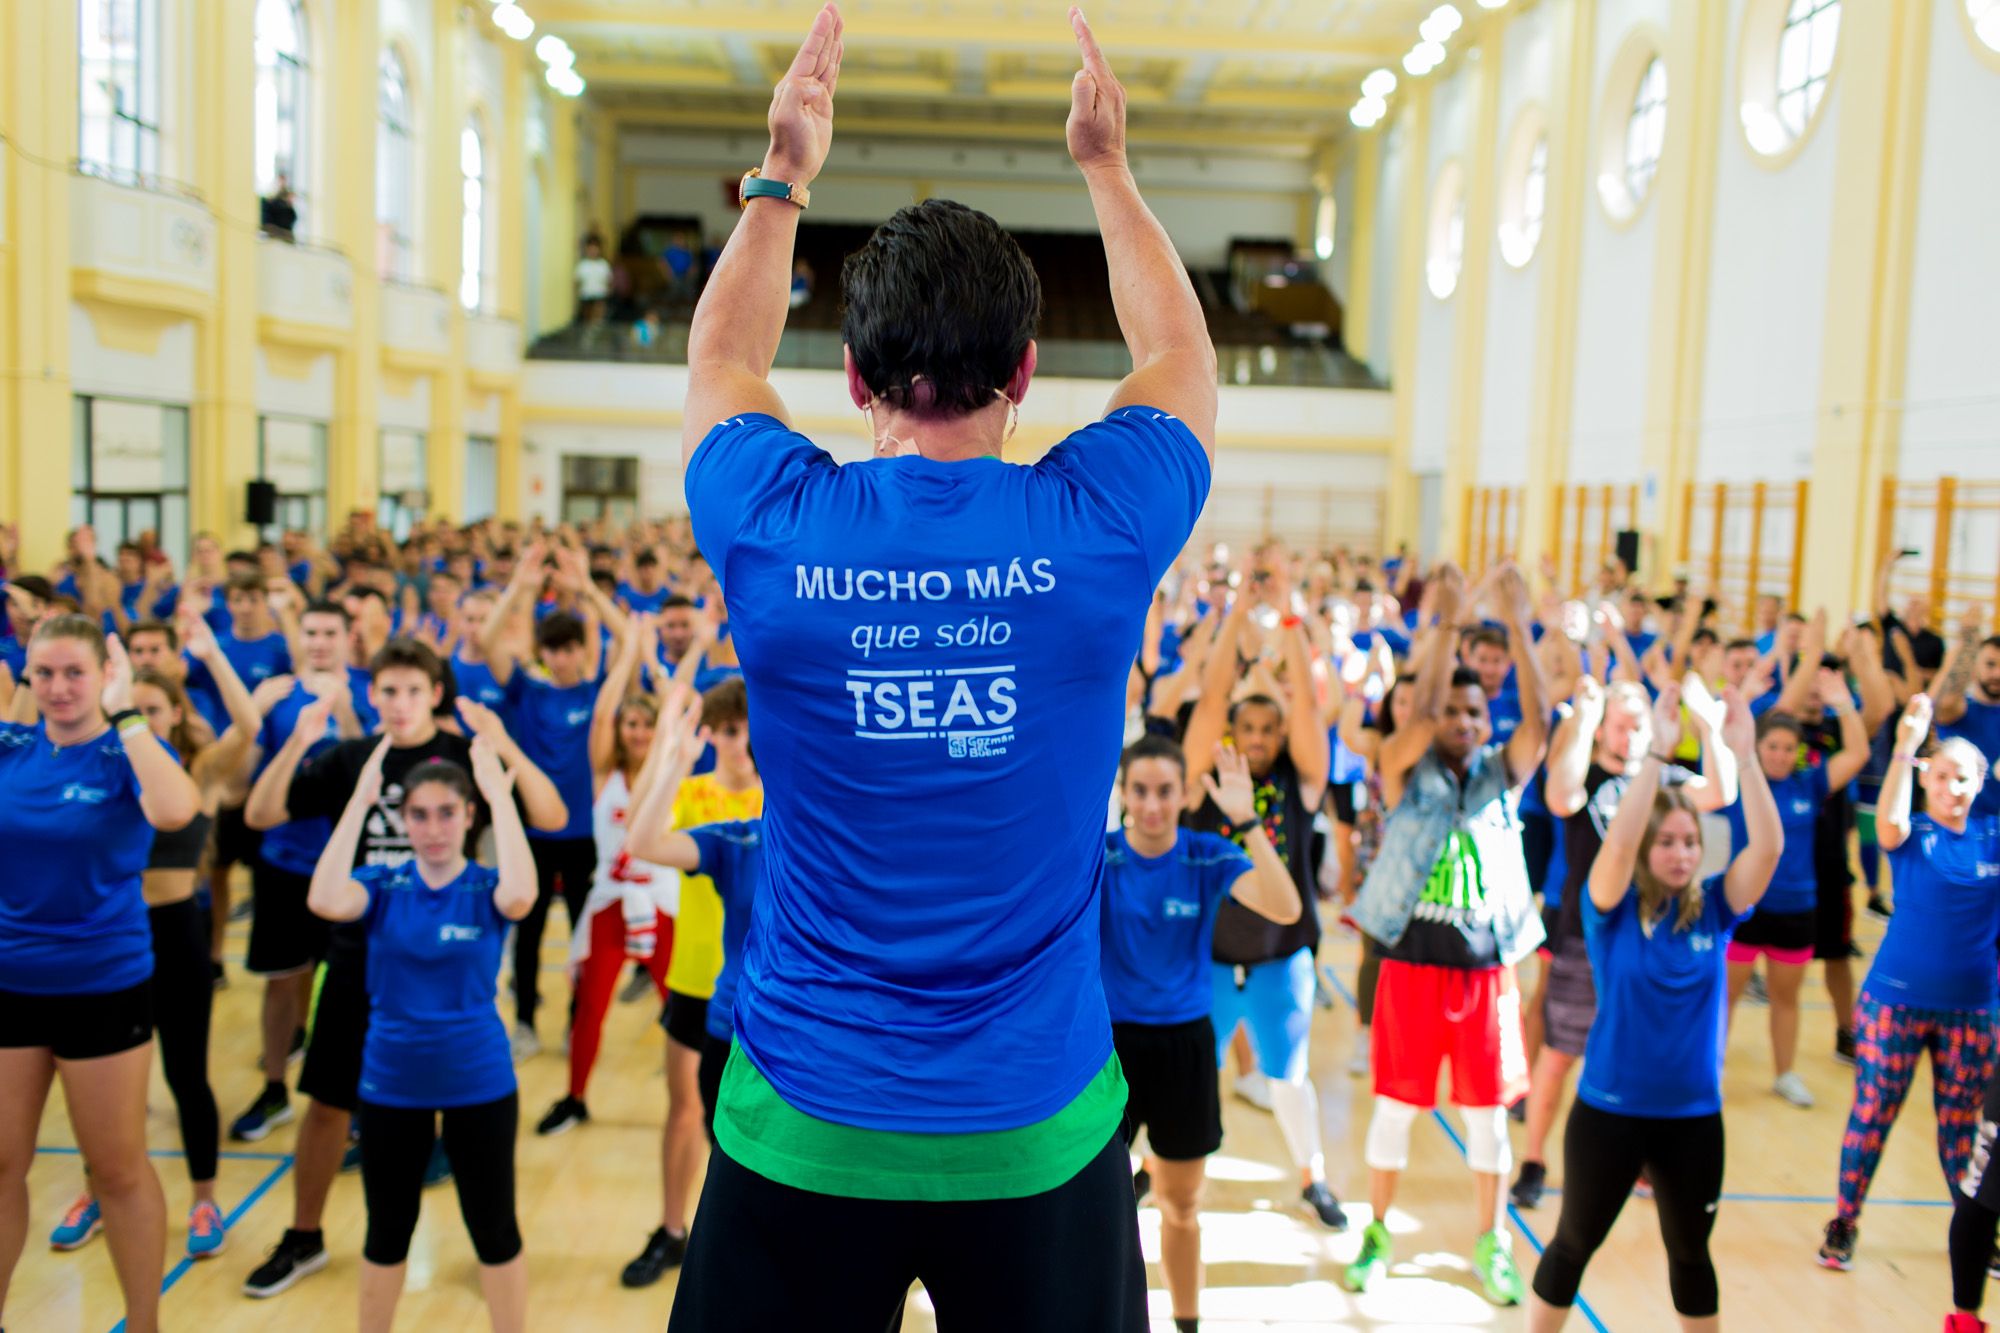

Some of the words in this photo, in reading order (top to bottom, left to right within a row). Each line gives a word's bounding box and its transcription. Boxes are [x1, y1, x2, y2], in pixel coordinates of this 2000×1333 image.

[795, 564, 952, 601] MUCHO
[965, 556, 1057, 600] MÁS
[850, 624, 921, 658] que
[934, 615, 1012, 647] sólo
[846, 677, 1018, 729] TSEAS
